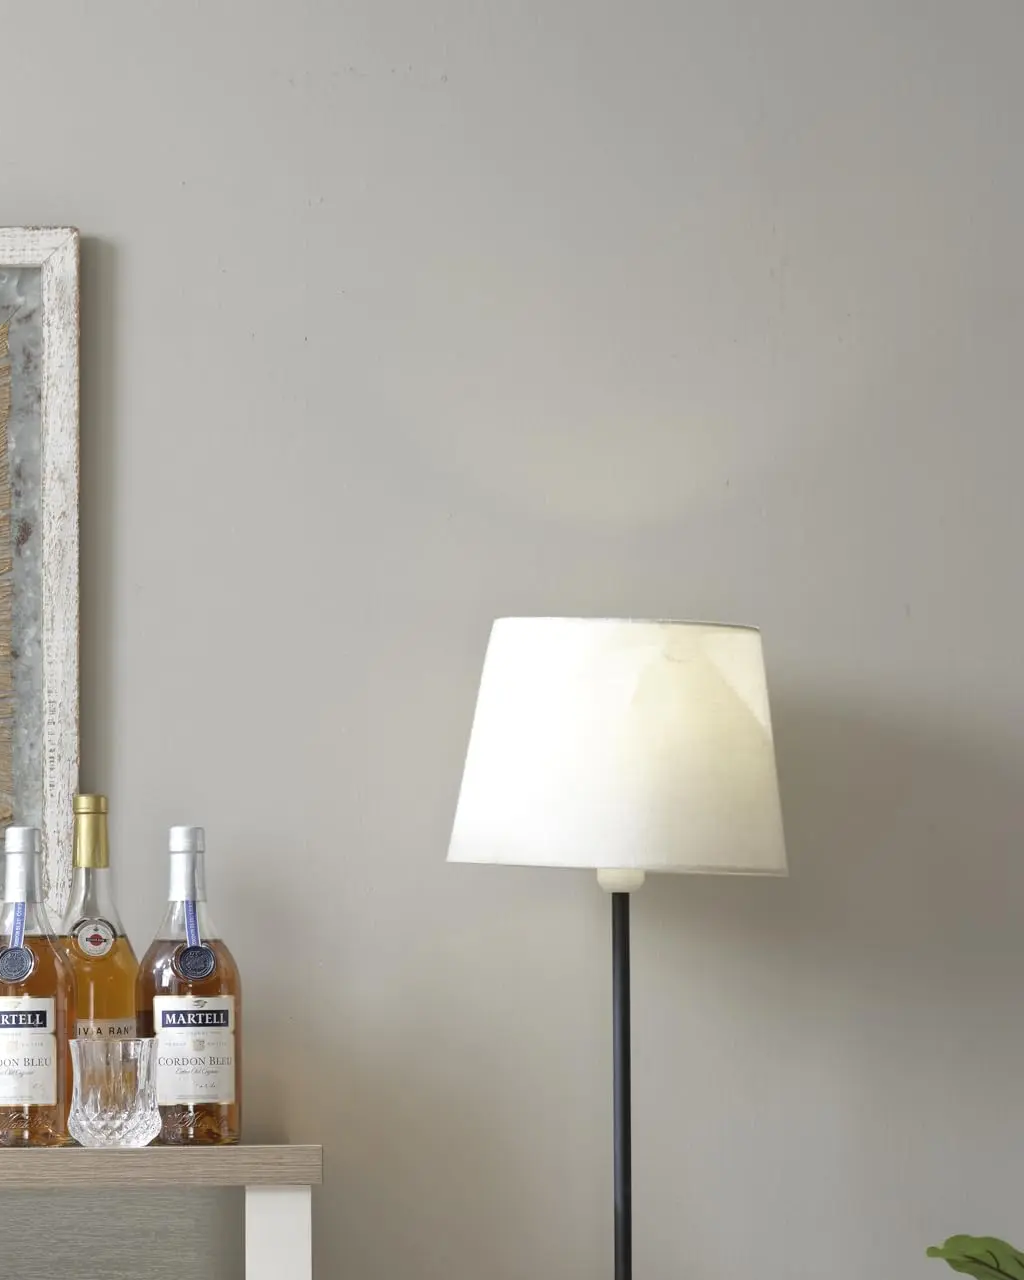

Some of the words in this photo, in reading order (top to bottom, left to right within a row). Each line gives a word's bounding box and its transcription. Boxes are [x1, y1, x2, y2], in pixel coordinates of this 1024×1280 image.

[165, 1013, 226, 1024] MARTELL
[109, 1026, 131, 1036] RAN
[23, 1057, 52, 1067] BLEU
[158, 1056, 206, 1066] CORDON
[209, 1056, 233, 1066] BLEU
